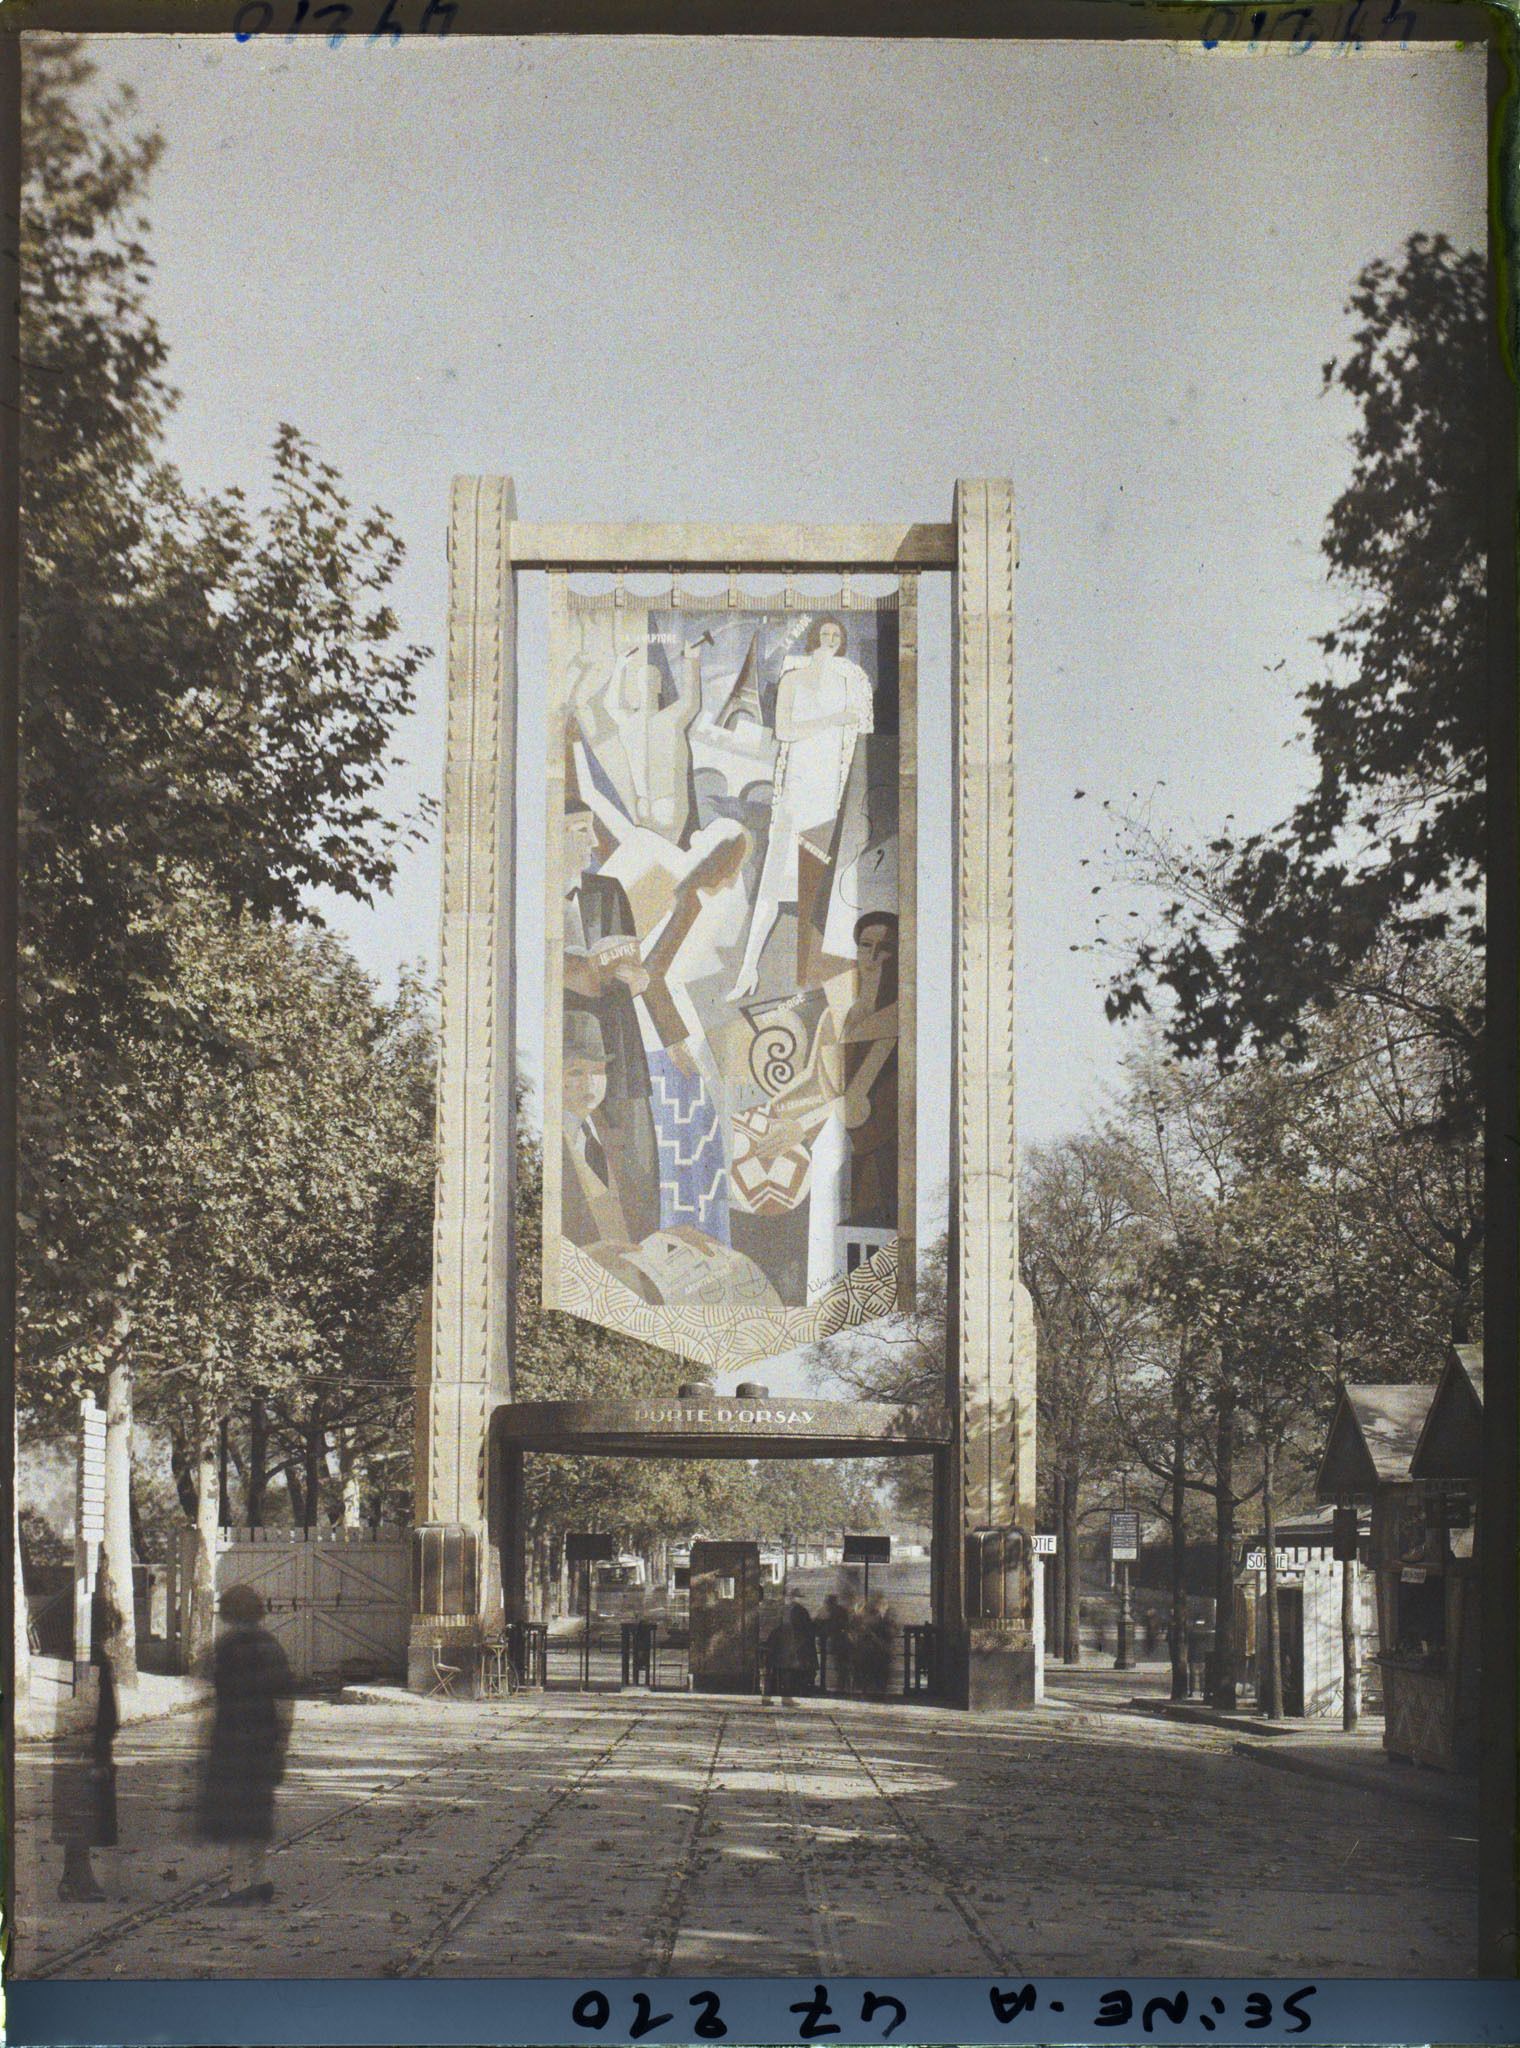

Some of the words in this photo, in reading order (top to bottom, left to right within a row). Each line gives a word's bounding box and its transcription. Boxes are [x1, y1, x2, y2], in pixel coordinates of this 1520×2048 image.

[635, 1409, 713, 1423] PORTE
[717, 1409, 816, 1425] D'ORSAY
[1247, 1554, 1286, 1569] SOIE
